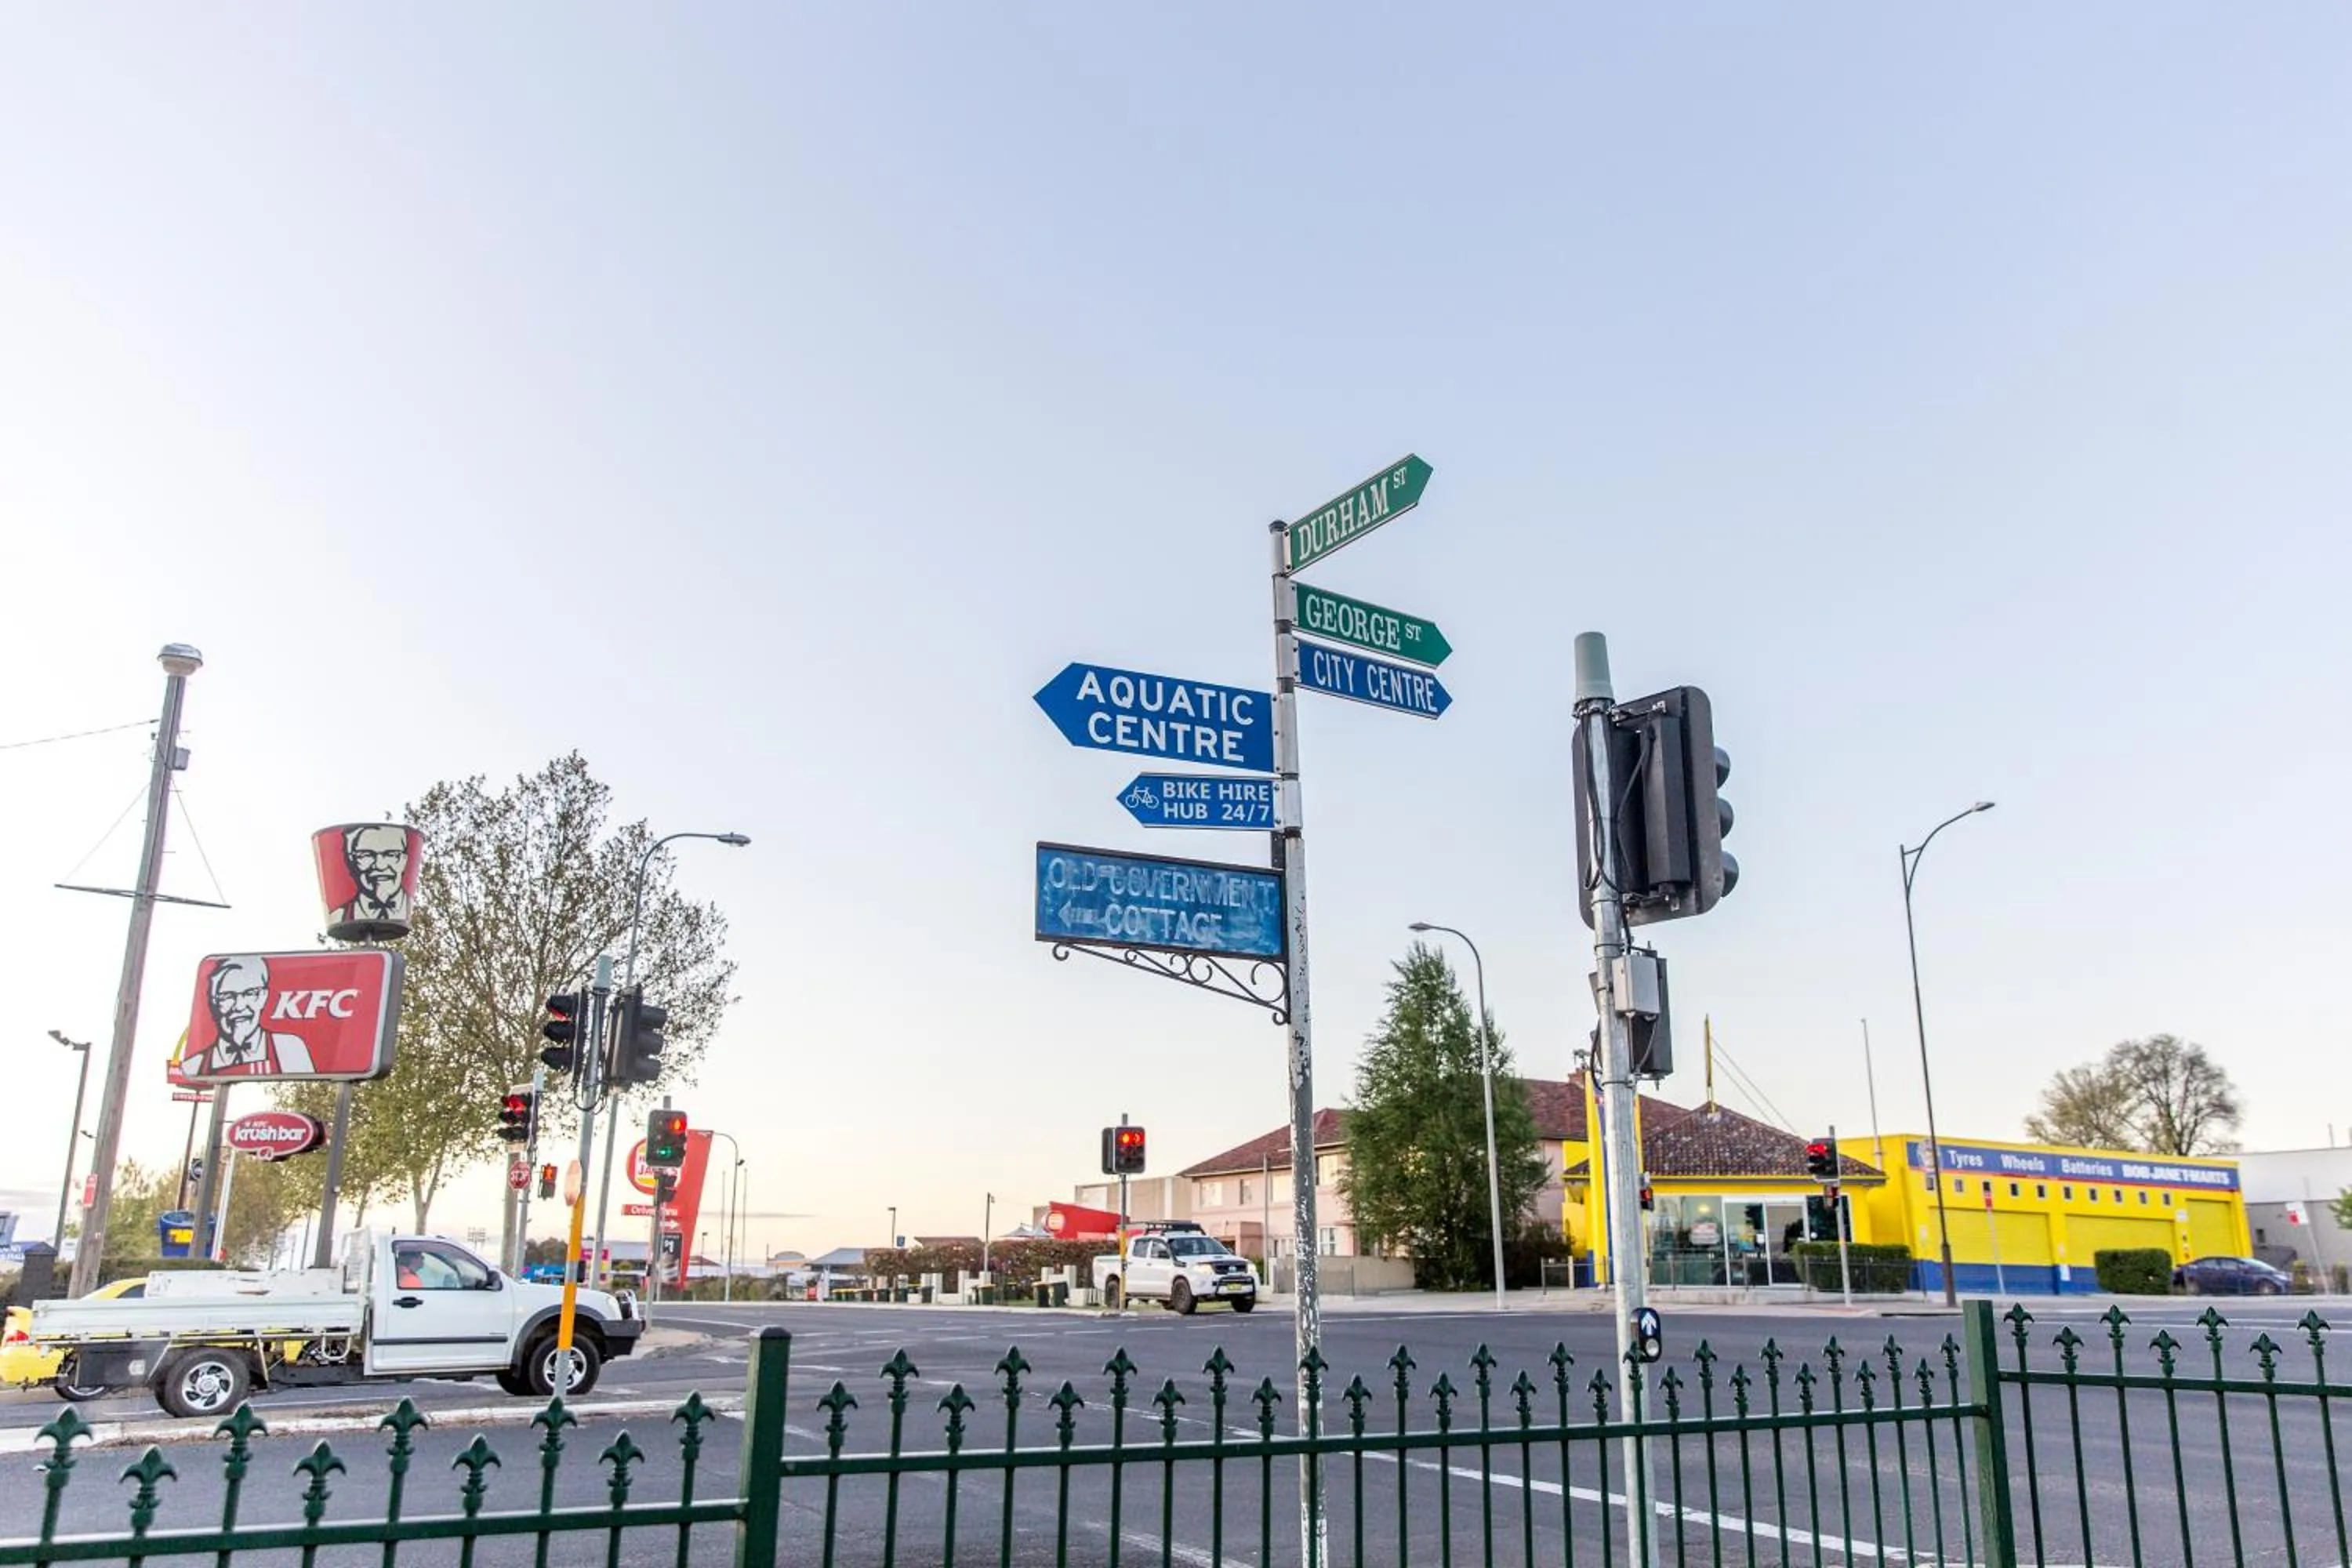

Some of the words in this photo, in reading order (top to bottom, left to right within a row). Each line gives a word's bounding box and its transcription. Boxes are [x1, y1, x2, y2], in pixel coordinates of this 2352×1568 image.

[1298, 477, 1389, 561] DURHAM
[1393, 466, 1406, 488] ST
[1305, 593, 1401, 651] GEORGE
[1405, 623, 1422, 641] ST
[1076, 670, 1254, 725] AQUATIC
[1313, 650, 1355, 693] CITY
[1367, 664, 1438, 713] CENTRE
[1088, 712, 1244, 763] CENTRE
[1163, 782, 1211, 800] BIKE
[1218, 784, 1269, 802] HIRE
[1163, 802, 1208, 819] HUB
[1221, 804, 1270, 822] 24/7
[1049, 858, 1097, 891] OLD
[1108, 865, 1275, 909] GOVERNMENT
[1105, 903, 1222, 944] COTTAGE
[270, 989, 359, 1019] KFC
[510, 1169, 529, 1181] STOP
[1947, 1149, 1984, 1168] Tyres
[2000, 1153, 2045, 1172] Wheels
[2061, 1158, 2114, 1177] Batteries
[2122, 1163, 2151, 1179] BOB
